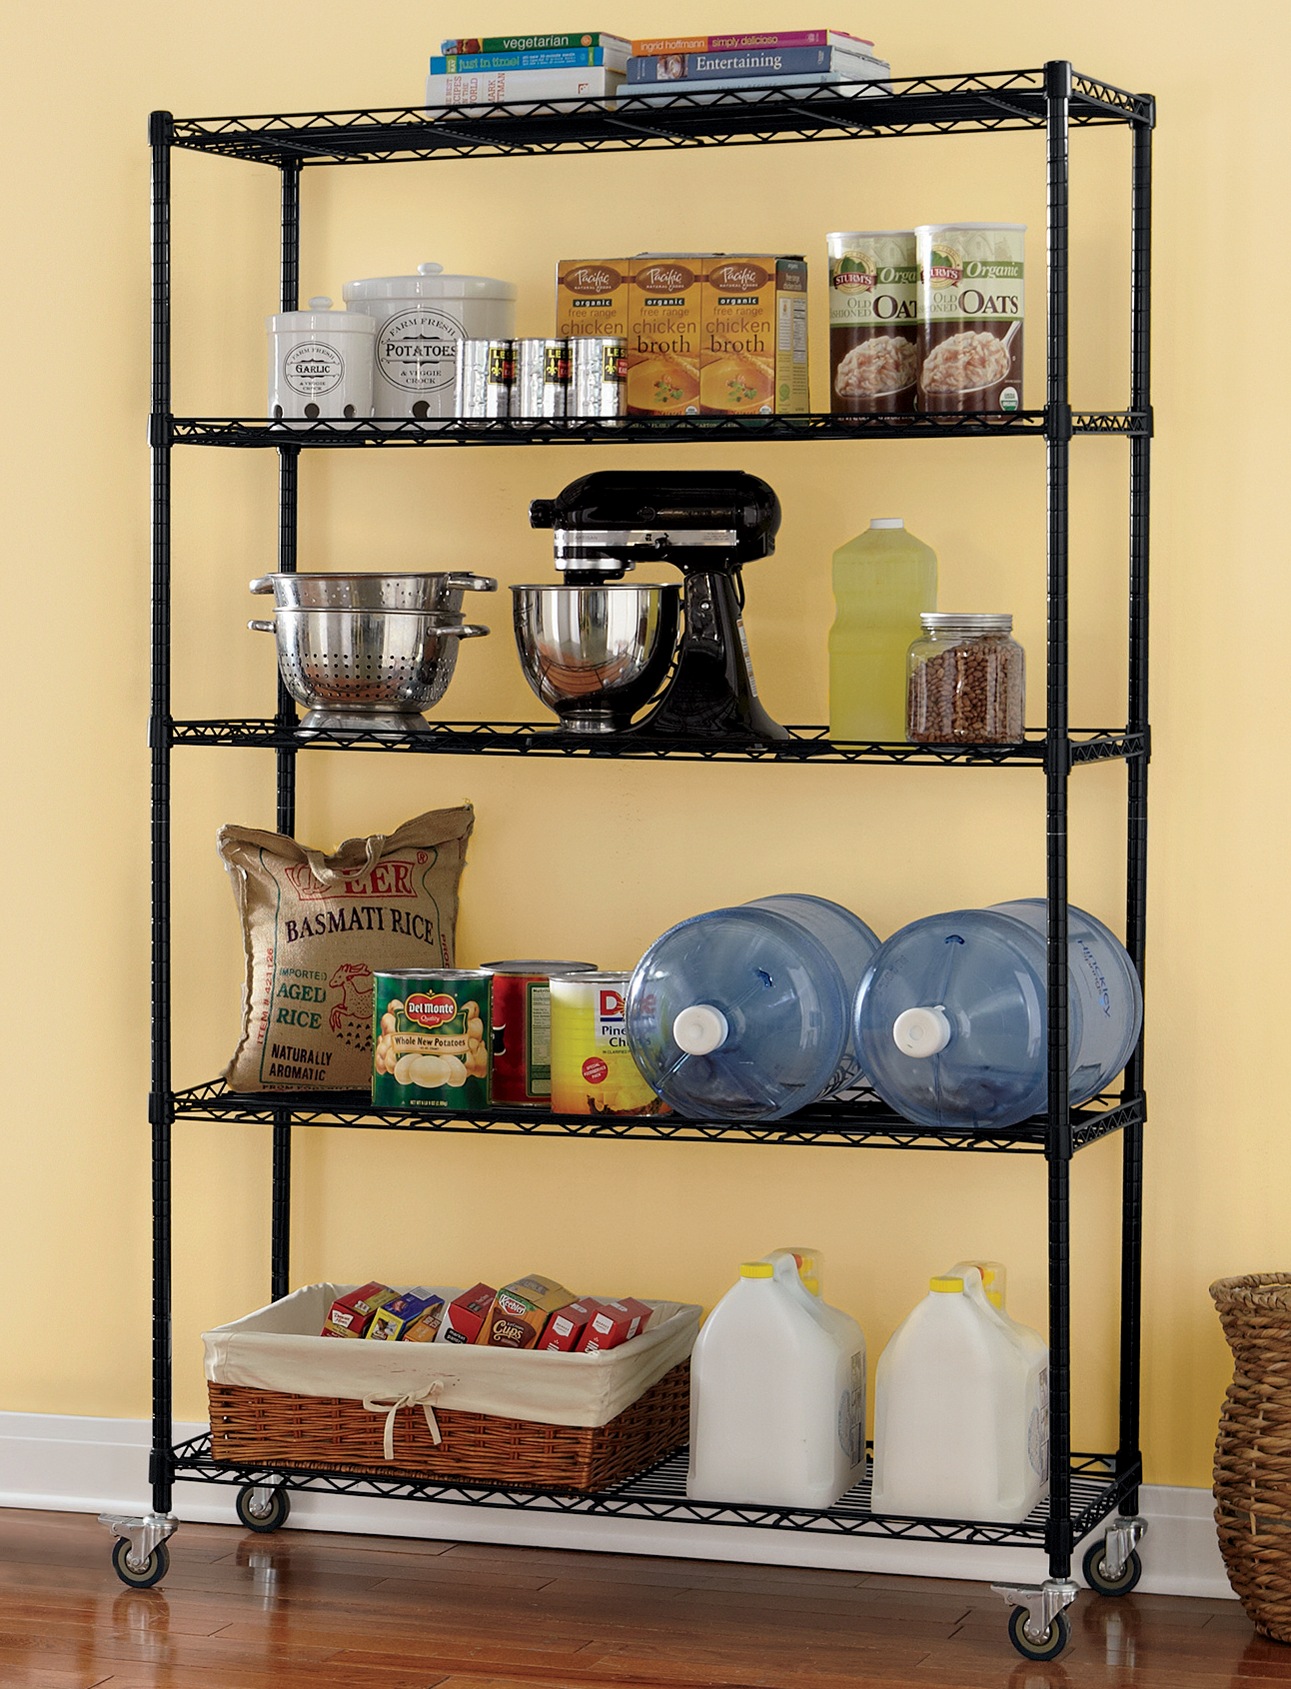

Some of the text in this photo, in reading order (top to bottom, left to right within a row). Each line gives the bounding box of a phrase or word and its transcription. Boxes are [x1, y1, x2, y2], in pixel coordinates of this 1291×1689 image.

[503, 35, 569, 51] vegetarian
[640, 39, 705, 53] ingrid hoffmann
[711, 35, 779, 48] simply delicioso
[458, 58, 478, 72] just
[480, 58, 491, 68] in
[696, 52, 782, 70] Entertaining
[453, 75, 462, 105] ECIPES
[470, 77, 478, 104] ORLD
[574, 268, 610, 287] Pacific
[646, 267, 682, 286] Pacific
[719, 266, 756, 285] Pacific
[929, 268, 958, 279] URM'S
[966, 261, 1019, 279] Organic
[835, 274, 872, 285] STURM'S
[574, 299, 611, 308] organic
[646, 298, 683, 307] organic
[720, 297, 757, 306] organic
[846, 297, 872, 309] OLD
[933, 291, 958, 304] OLD
[957, 289, 1019, 315] OATS
[568, 307, 617, 319] free range
[640, 306, 690, 318] free range
[713, 305, 763, 318] free range
[389, 317, 456, 337] FARM FRESH
[561, 319, 624, 335] chicken
[632, 318, 697, 334] chicken
[705, 317, 771, 334] chicken
[386, 343, 456, 357] POTATOES
[637, 334, 690, 354] broth
[710, 334, 765, 353] broth
[295, 364, 331, 374] GARLIC
[290, 864, 412, 895] EER
[285, 906, 434, 946] BASMATI RICE
[280, 967, 328, 981] IMPORTED
[256, 1011, 269, 1045] ITEM
[264, 948, 274, 994] 421126
[276, 982, 327, 1004] AGED
[408, 1002, 454, 1014] Del Monte
[276, 1007, 322, 1030] RICE
[420, 1014, 440, 1024] Quality
[395, 1036, 466, 1047] Whole New Potatoes
[609, 1036, 628, 1048] Ch
[271, 1043, 333, 1067] NATURALLY
[269, 1062, 327, 1082] AROMATIC
[501, 1294, 525, 1315] Keebler
[493, 1319, 524, 1341] Cups
